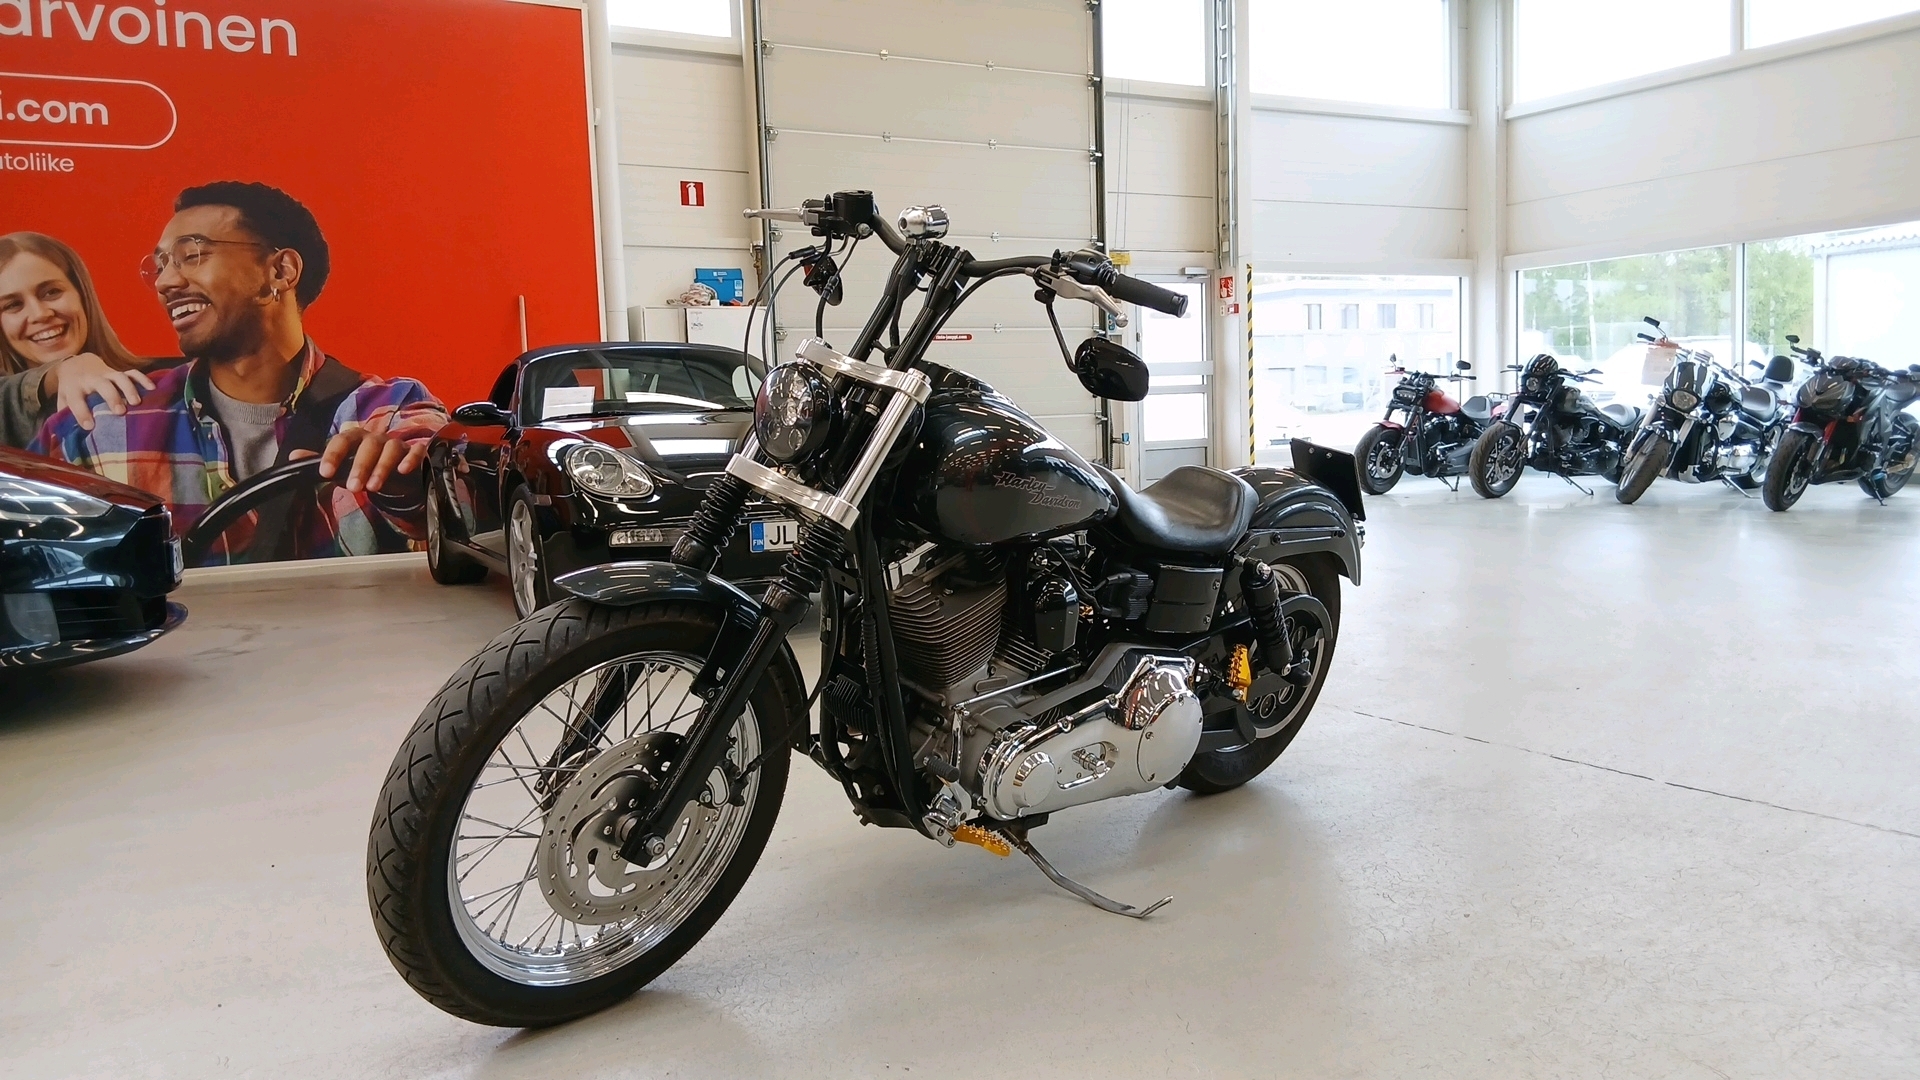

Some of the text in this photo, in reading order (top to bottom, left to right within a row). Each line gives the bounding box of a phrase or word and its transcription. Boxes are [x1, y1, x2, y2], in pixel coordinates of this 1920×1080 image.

[0, 152, 75, 173] toliike
[1028, 491, 1081, 509] Davidson
[769, 525, 800, 546] JL
